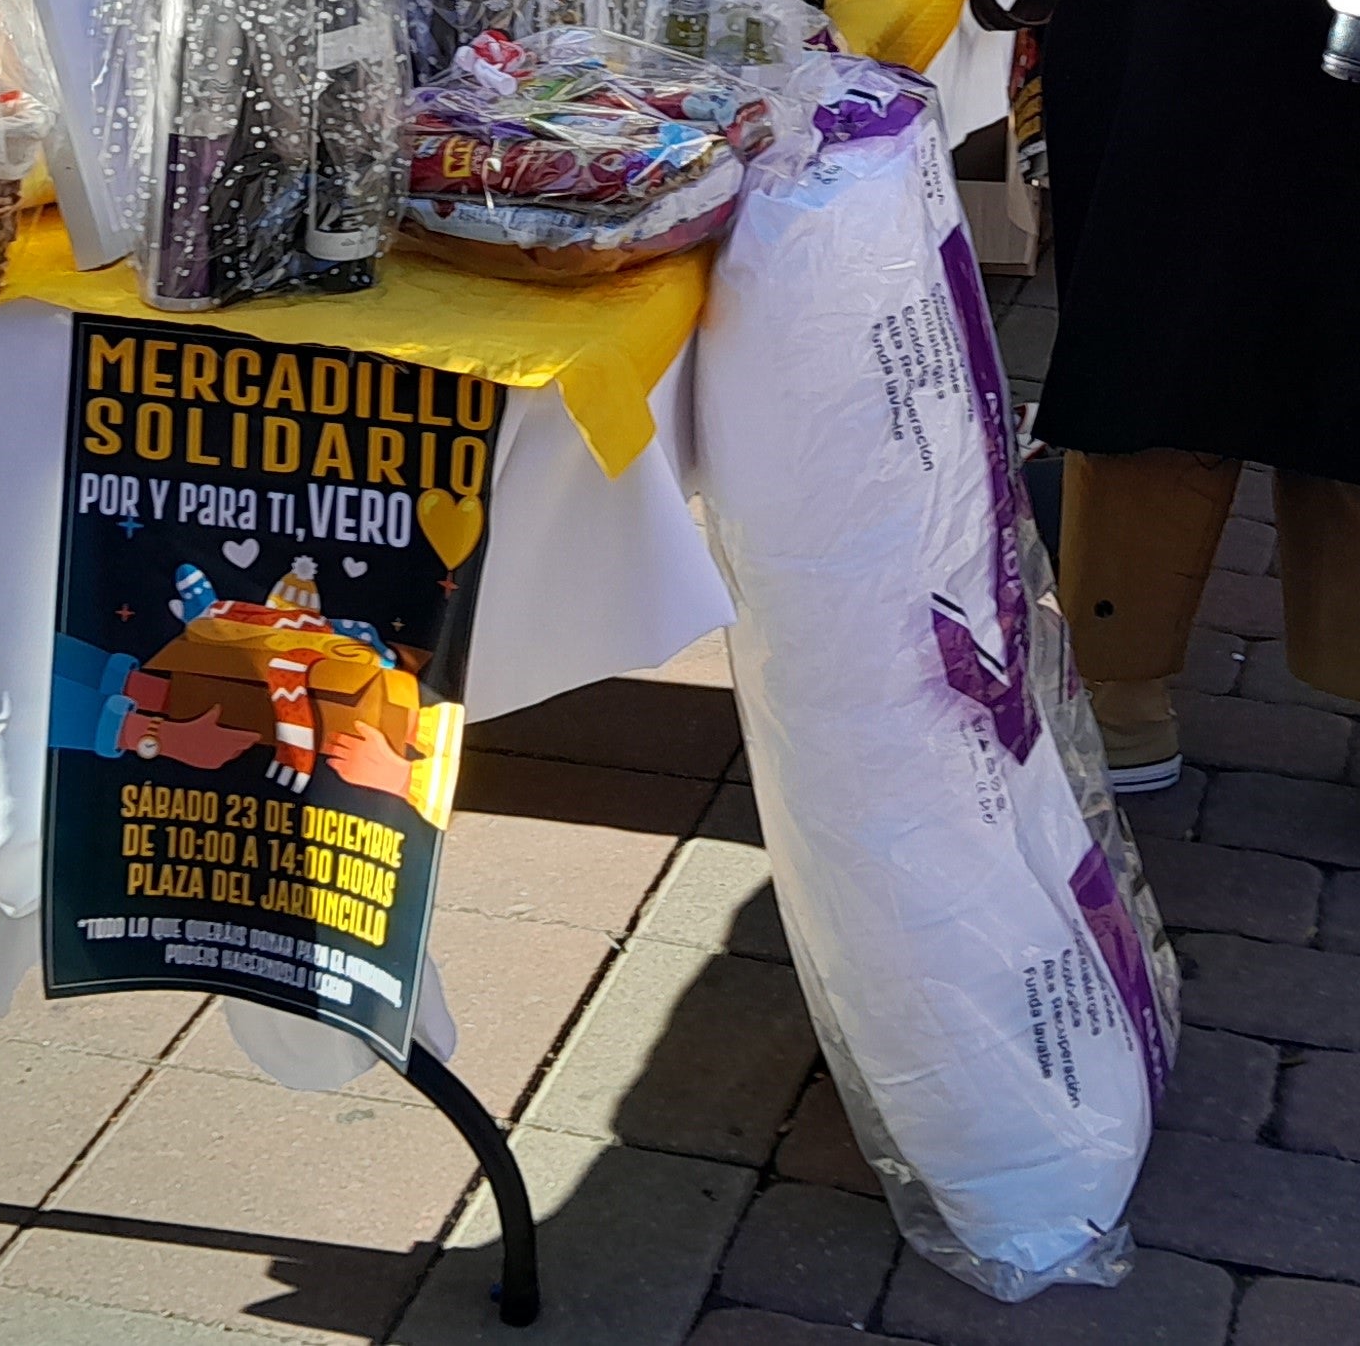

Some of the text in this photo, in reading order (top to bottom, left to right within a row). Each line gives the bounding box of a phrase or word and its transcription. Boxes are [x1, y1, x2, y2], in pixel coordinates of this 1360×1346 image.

[87, 334, 496, 431] MERCADILLO
[83, 396, 489, 497] SOLIDARIO
[78, 472, 140, 518] POR
[148, 477, 172, 521] Y
[120, 780, 405, 869] SÁBADO 23 DE DICIEMBRE
[122, 823, 396, 908] DE 10:00 A 14:00 HORAS
[127, 862, 388, 948] PLAZA DEL JARDINCILLO
[1023, 966, 1043, 1018] Funda
